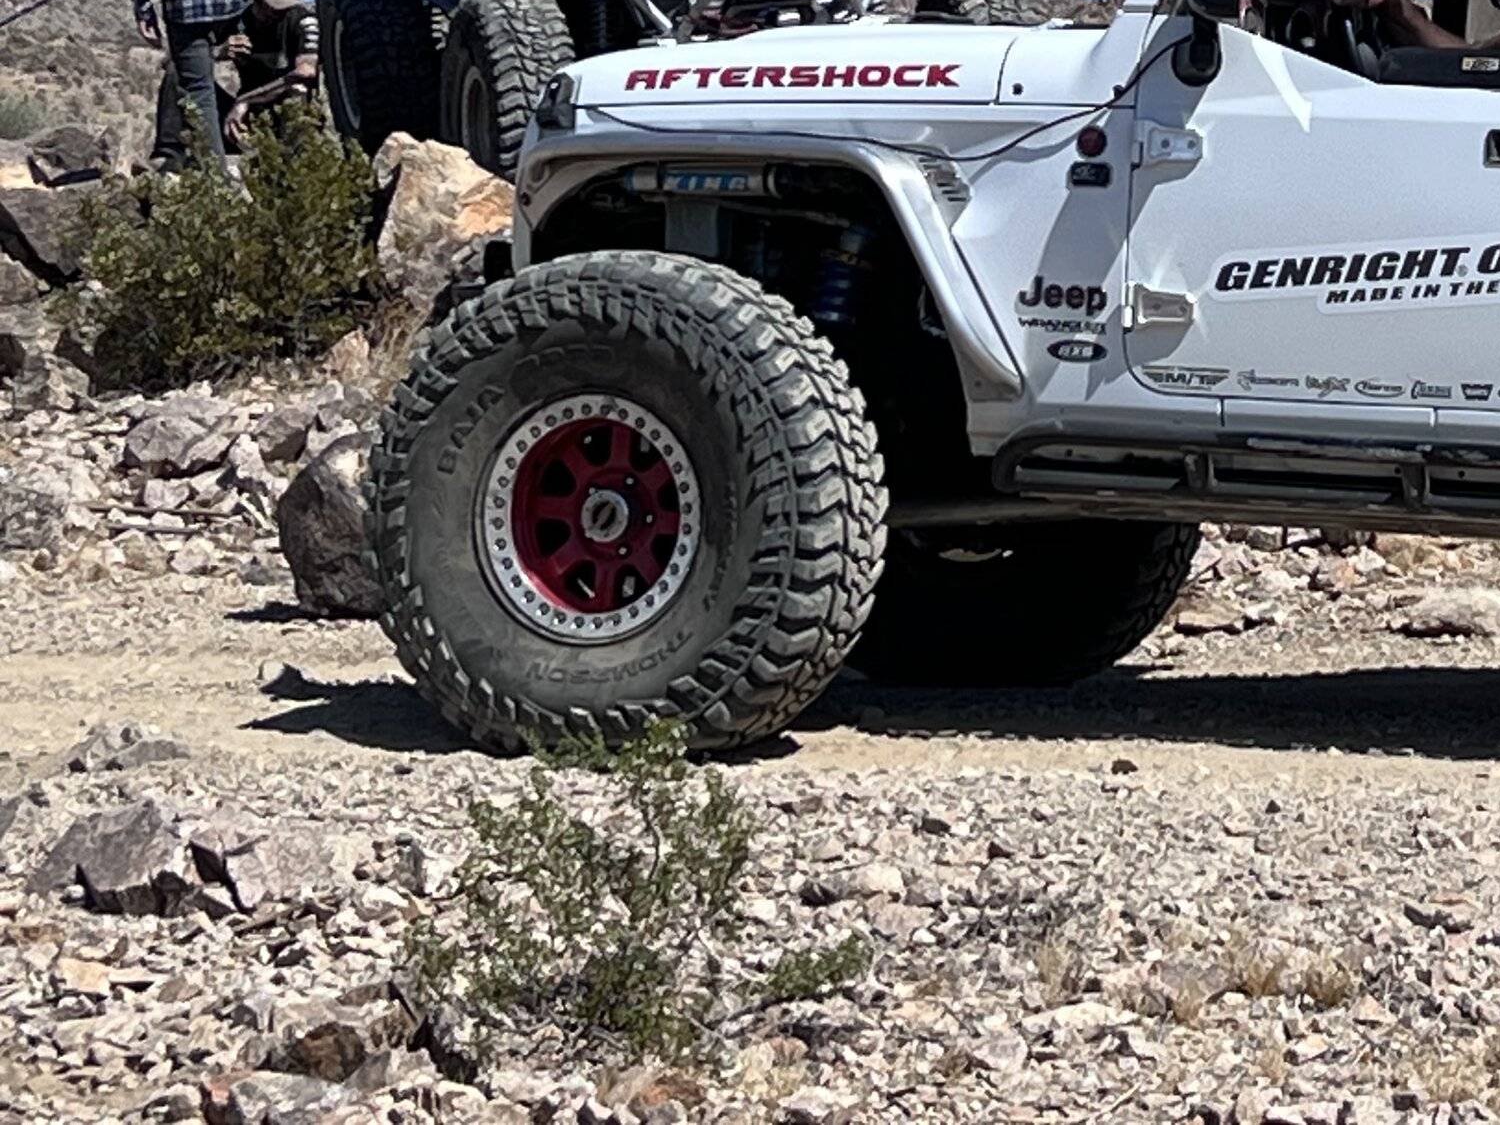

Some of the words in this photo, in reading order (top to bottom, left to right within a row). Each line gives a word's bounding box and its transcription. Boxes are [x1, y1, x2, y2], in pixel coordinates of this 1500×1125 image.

[625, 64, 964, 91] AFTERSHOCK
[1214, 246, 1471, 292] GENRIGHT
[1018, 275, 1108, 317] Jeep
[1325, 286, 1405, 305] MADE
[1410, 282, 1442, 299] IN
[1448, 279, 1500, 297] THE
[436, 385, 506, 476] BAJA
